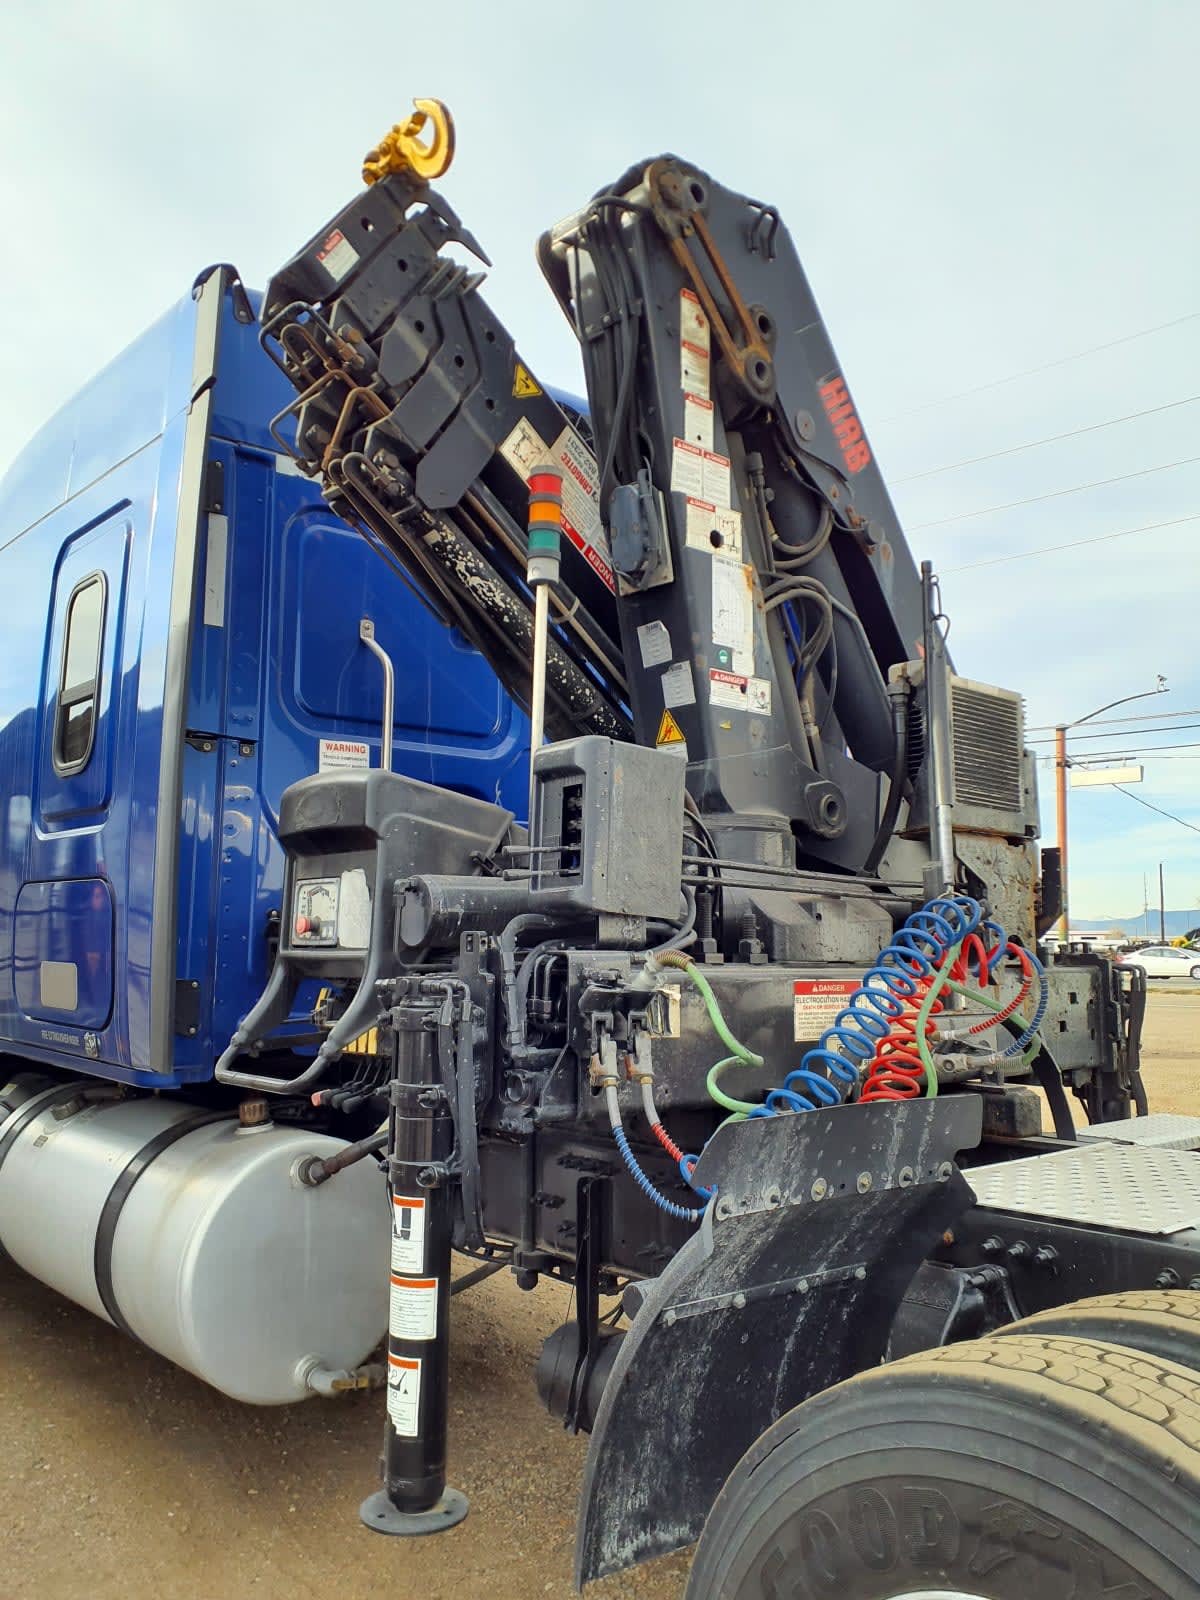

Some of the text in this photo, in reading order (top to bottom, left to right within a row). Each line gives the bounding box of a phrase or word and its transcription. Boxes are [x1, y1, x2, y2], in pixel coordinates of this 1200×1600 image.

[819, 376, 871, 474] HIAB
[560, 451, 594, 496] CARGOTEC
[720, 673, 745, 685] DANGER
[325, 743, 366, 754] WARNING
[818, 984, 846, 993] DANGER
[795, 996, 840, 1004] ELECTROCUTION
